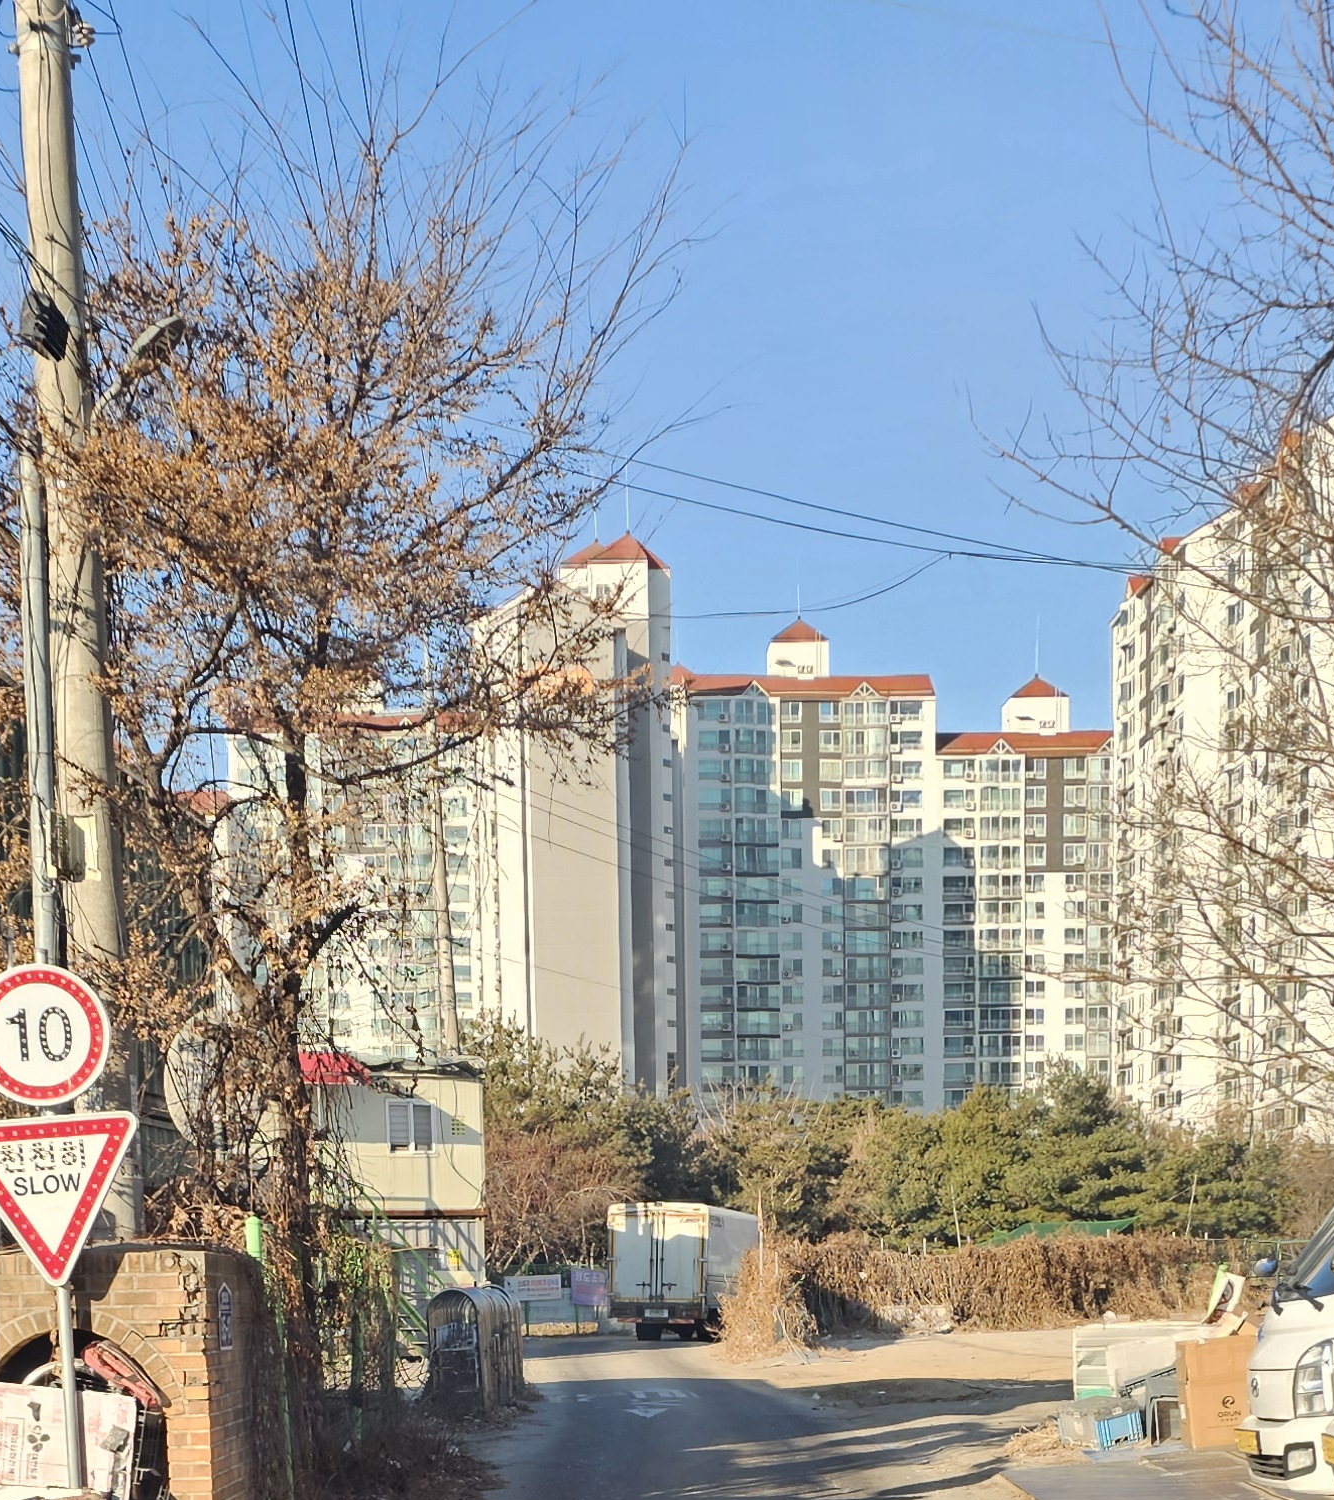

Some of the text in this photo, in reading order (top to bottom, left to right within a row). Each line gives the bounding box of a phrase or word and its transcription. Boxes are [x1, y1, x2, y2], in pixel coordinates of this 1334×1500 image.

[5, 1006, 73, 1062] 10
[13, 1172, 81, 1196] SLOW
[1218, 1410, 1241, 1418] ORUN
